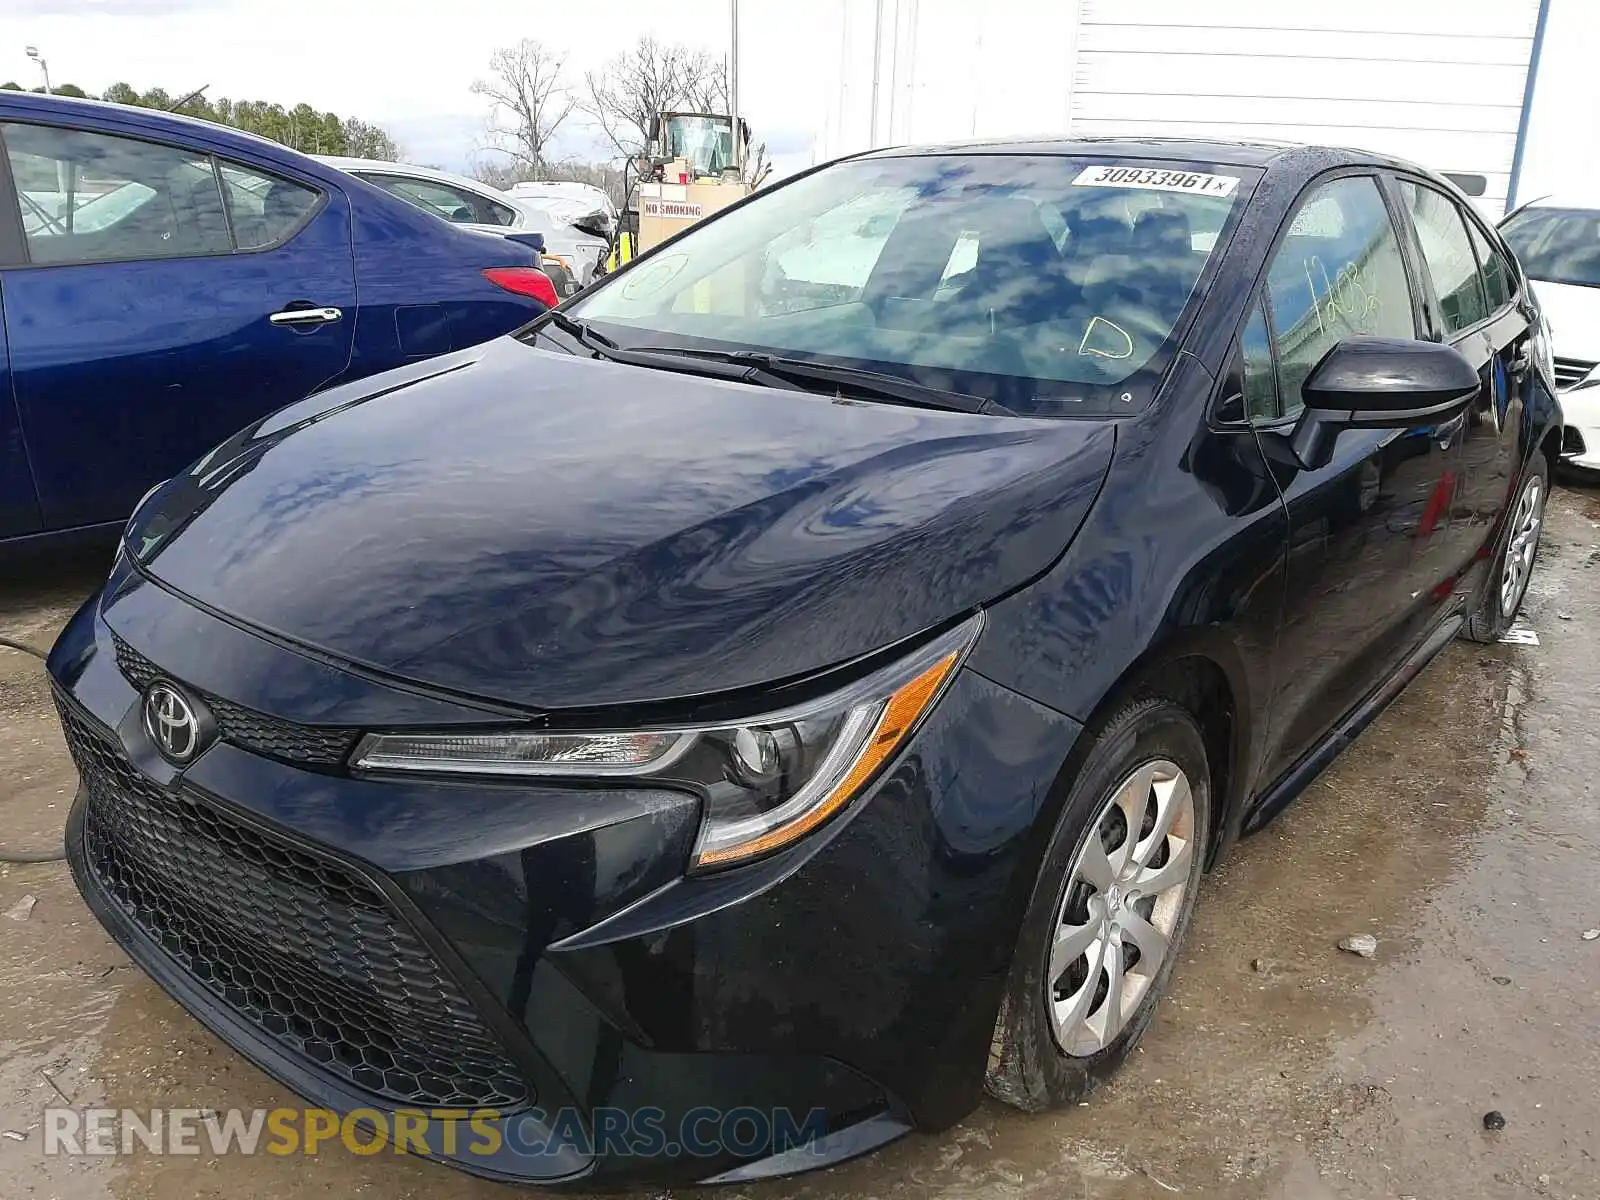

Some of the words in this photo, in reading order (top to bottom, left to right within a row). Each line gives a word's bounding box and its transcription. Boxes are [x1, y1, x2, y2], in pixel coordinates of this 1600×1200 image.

[1094, 167, 1215, 190] 30933961
[645, 203, 658, 215] NO
[660, 203, 701, 217] SMOKING
